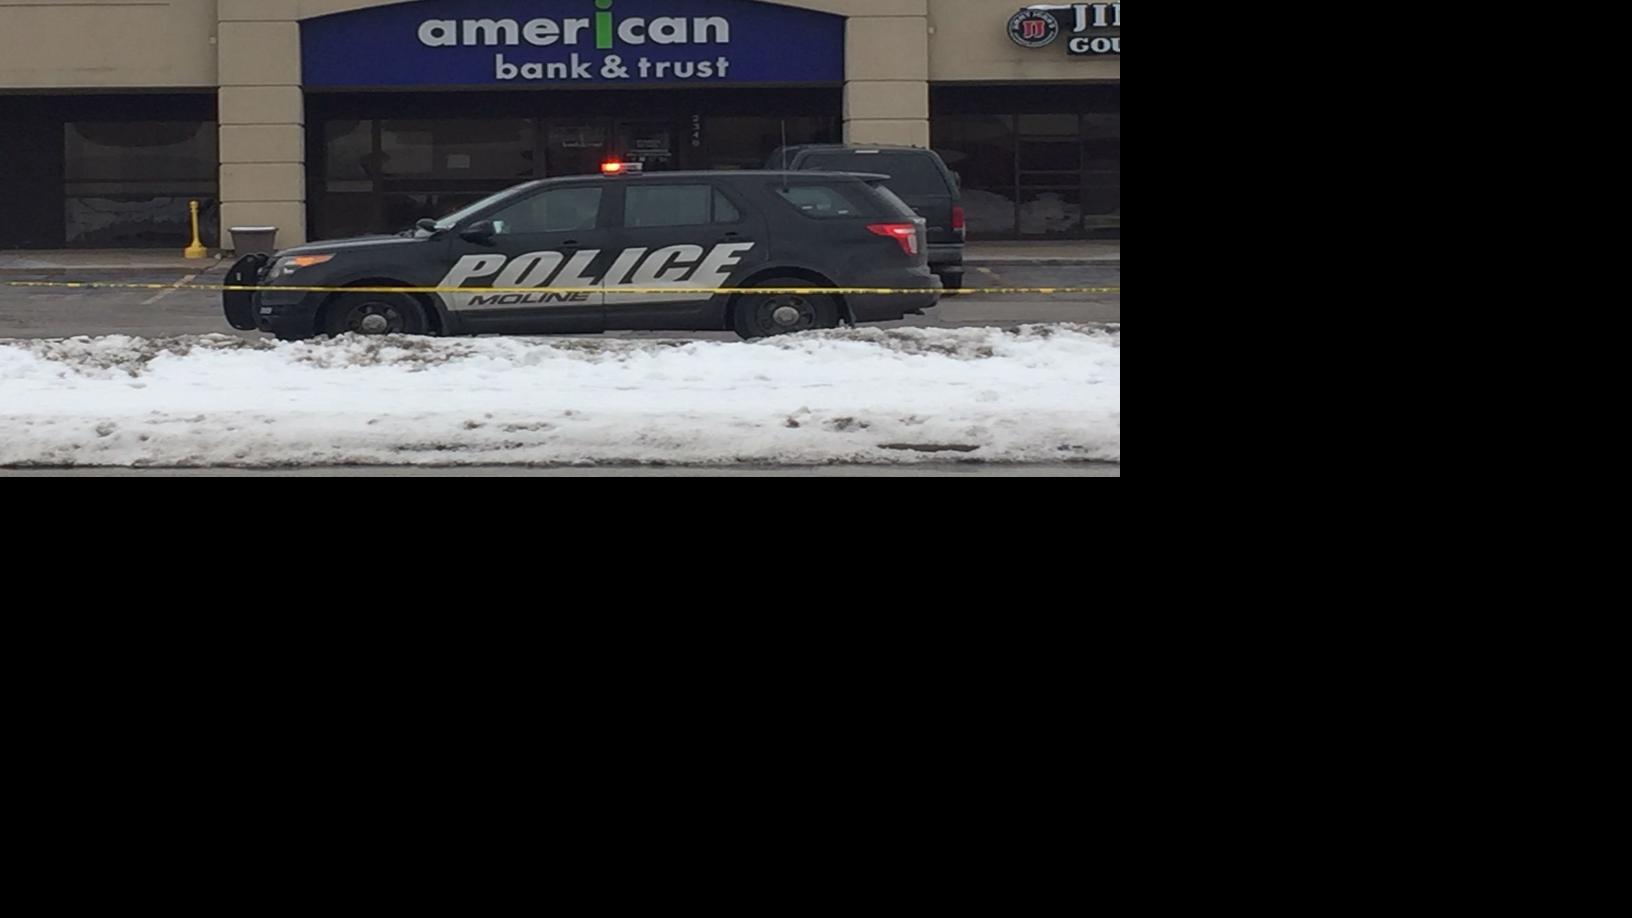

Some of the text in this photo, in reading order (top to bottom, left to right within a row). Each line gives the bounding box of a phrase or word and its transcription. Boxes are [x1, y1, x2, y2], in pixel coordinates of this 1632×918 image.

[417, 0, 730, 49] american
[495, 54, 730, 80] bank & trust
[438, 242, 755, 289] POLICE
[468, 291, 594, 306] MOLINE
